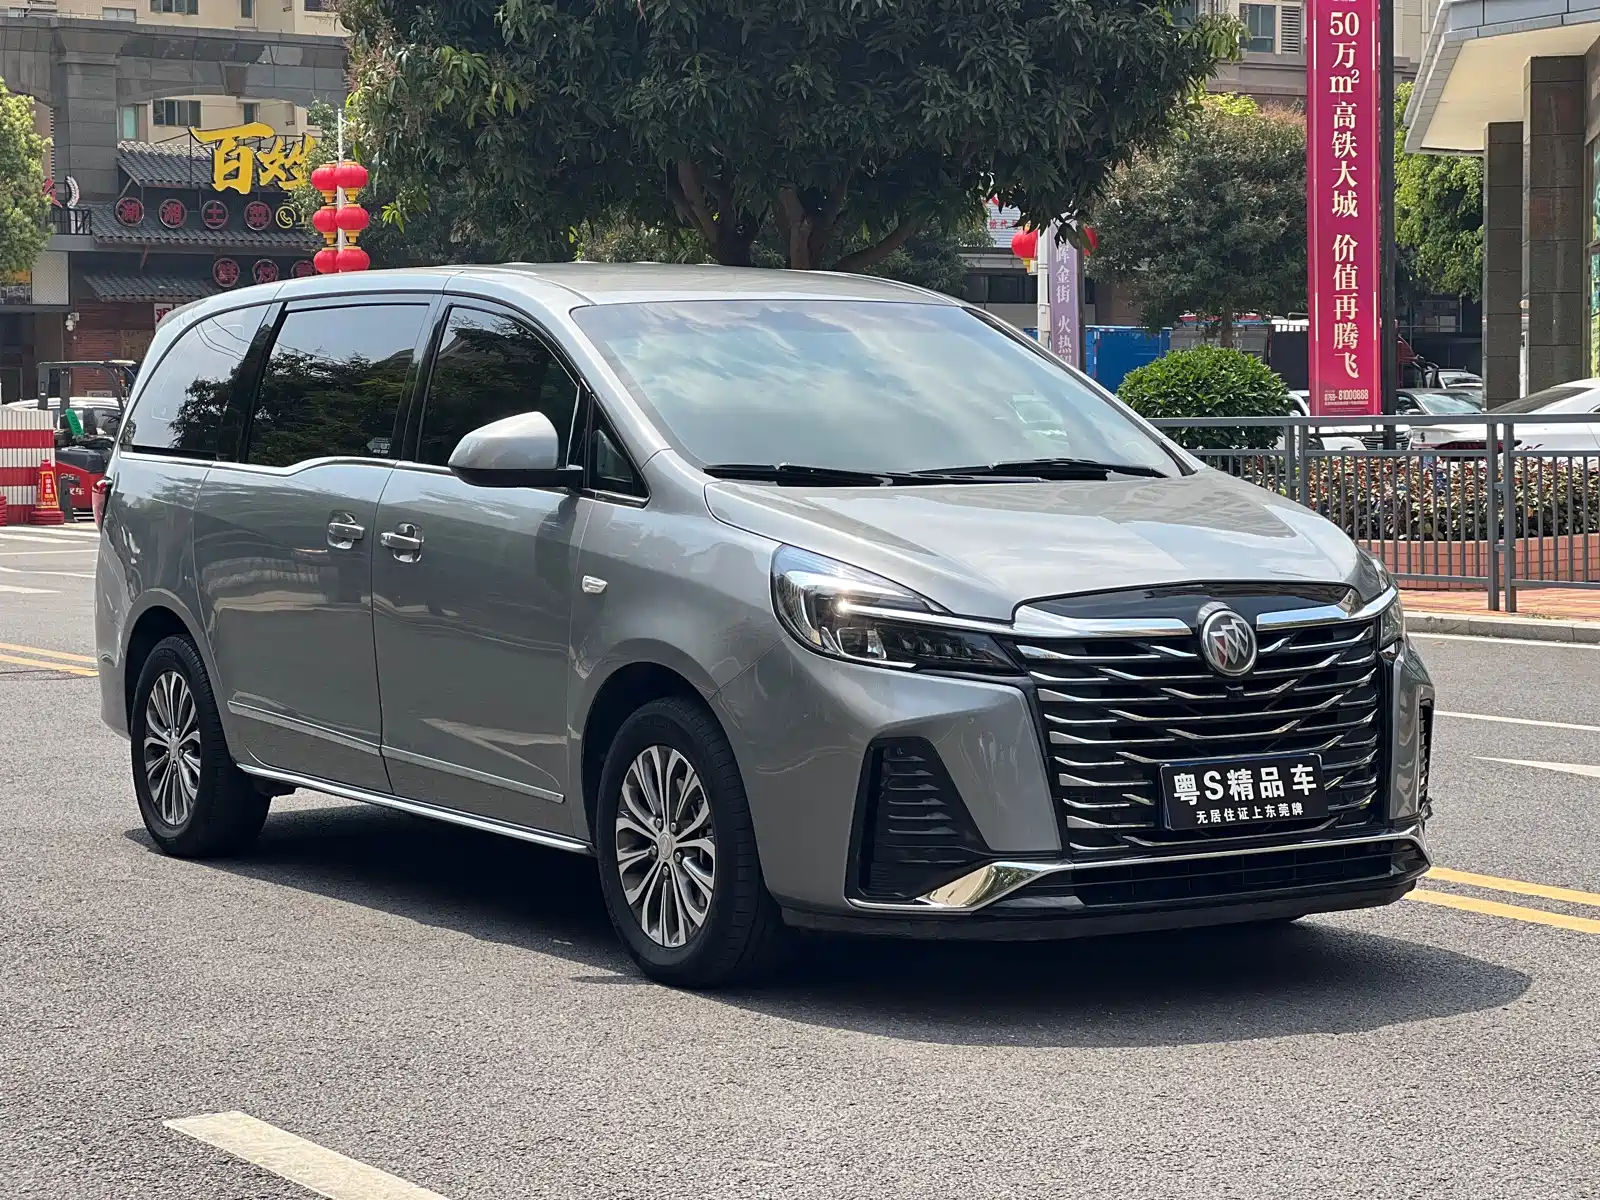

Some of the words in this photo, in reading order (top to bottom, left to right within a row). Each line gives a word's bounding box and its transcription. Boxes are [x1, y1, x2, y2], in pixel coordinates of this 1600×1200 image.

[1332, 233, 1360, 379] 价值再腾飞
[1173, 763, 1318, 806] 粤S精品车
[1196, 802, 1304, 825] 无居住证上东莞牌
